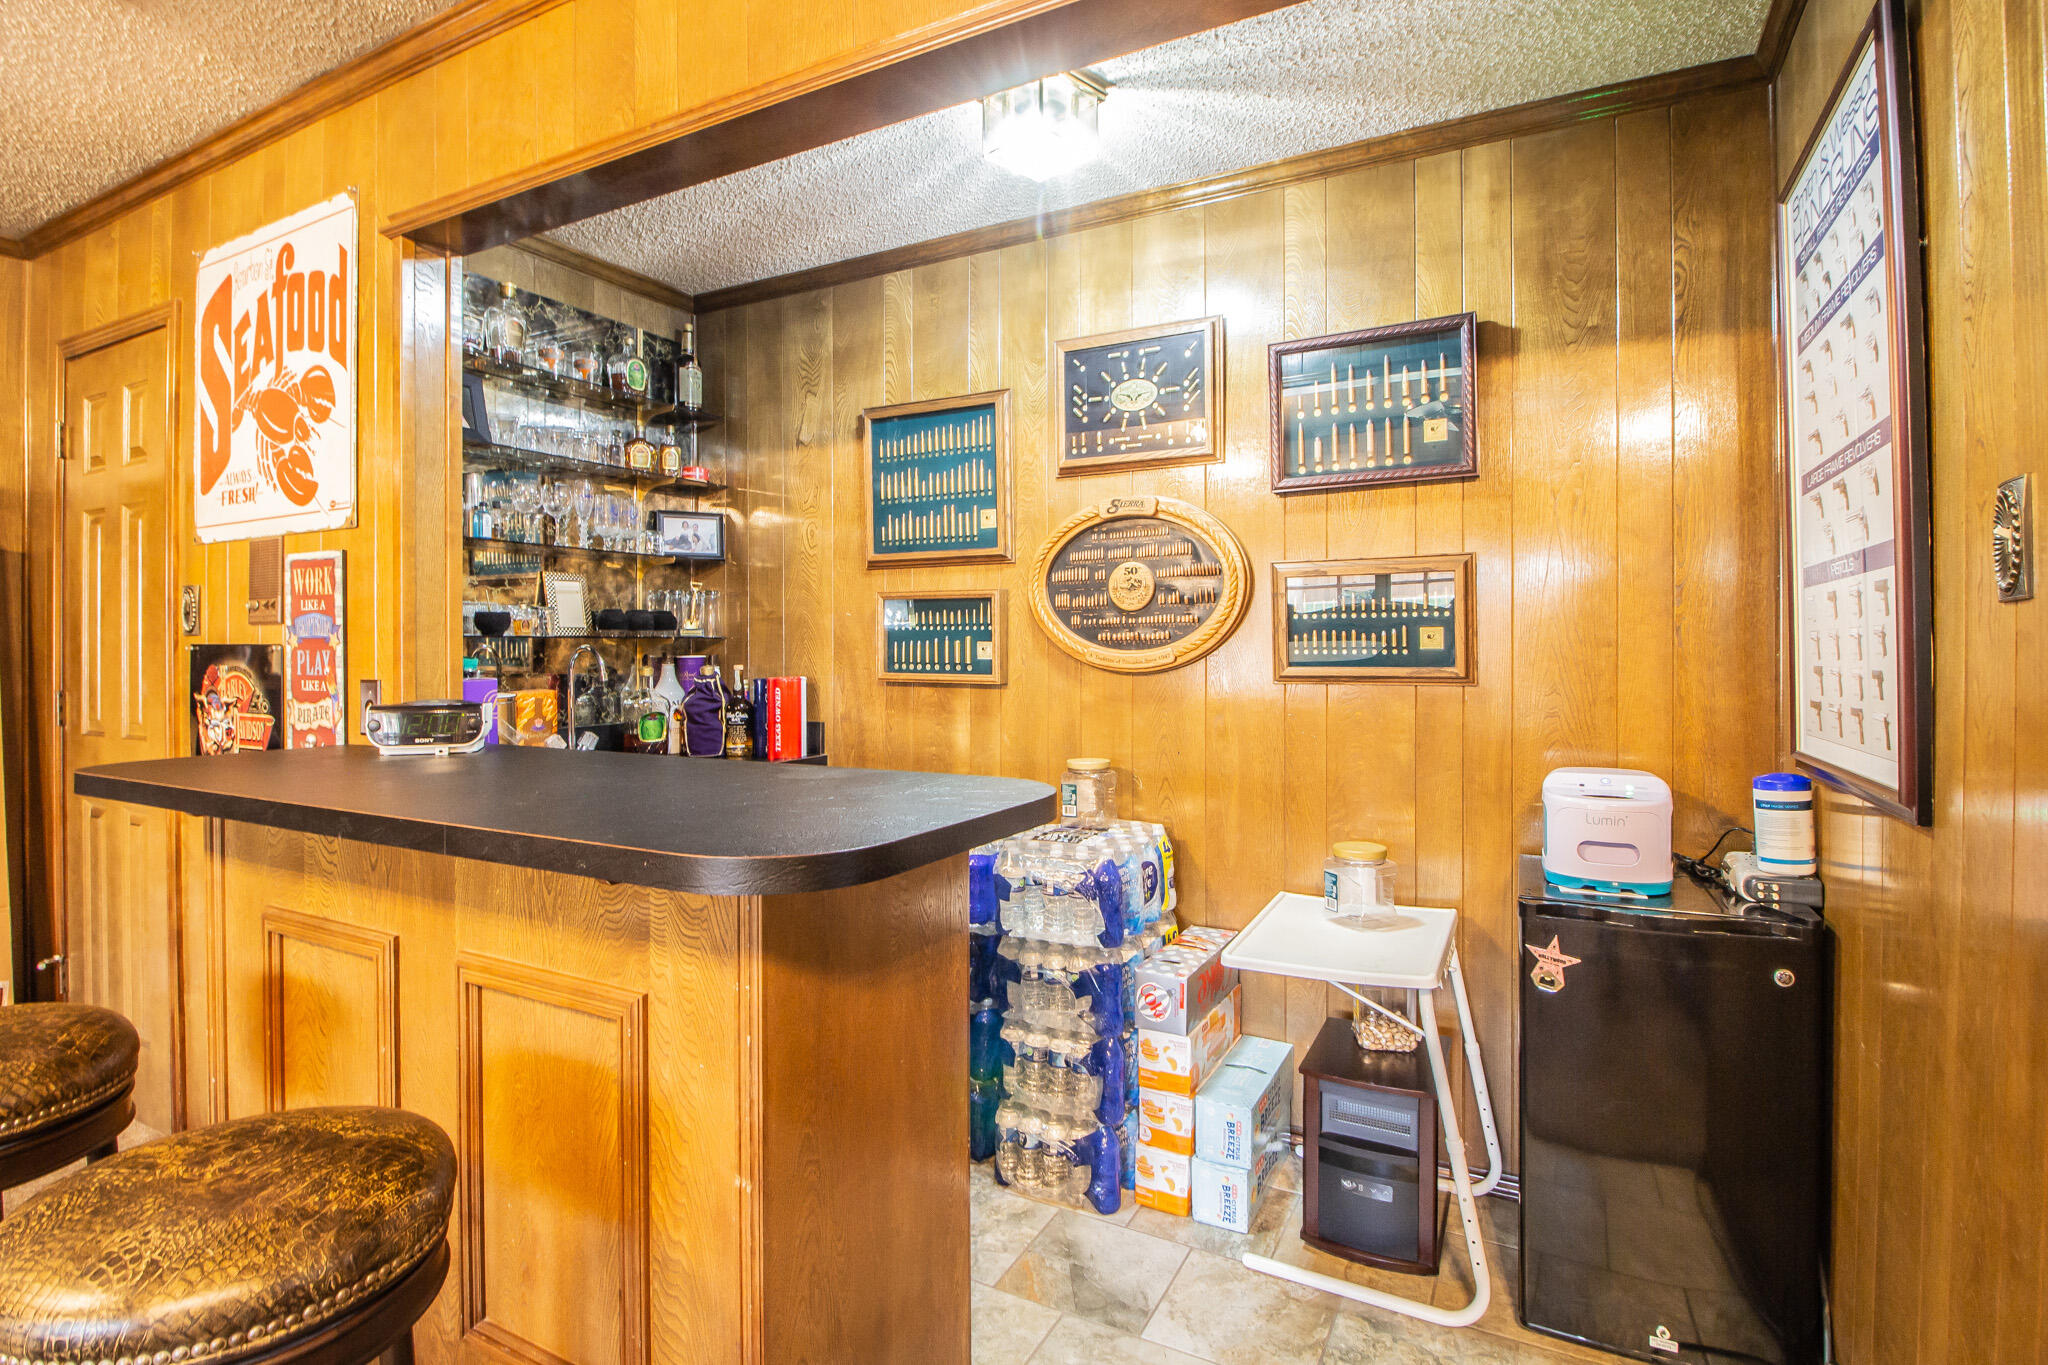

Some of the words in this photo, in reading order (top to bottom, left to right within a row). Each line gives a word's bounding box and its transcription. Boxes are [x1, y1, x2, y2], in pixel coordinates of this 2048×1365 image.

[1793, 87, 1879, 258] HANDGUNS
[1836, 147, 1872, 208] REVOLVERS
[1841, 245, 1877, 299] REVOLVERS
[1806, 467, 1825, 488] LARGE
[1824, 454, 1845, 479] FRAME
[1844, 428, 1881, 463] REVOLVERS
[293, 565, 333, 596] WORK
[1124, 567, 1138, 576] 50
[300, 599, 319, 612] LIKE
[319, 599, 326, 611] A
[297, 650, 331, 677] PLAY
[301, 680, 319, 692] LIKE
[320, 680, 327, 692] A
[297, 704, 331, 724] PIRATE
[1585, 811, 1626, 827] Lumin
[1140, 984, 1167, 1020] Coke
[1226, 1121, 1236, 1160] BREEZE
[1222, 1184, 1232, 1224] BREEZE
